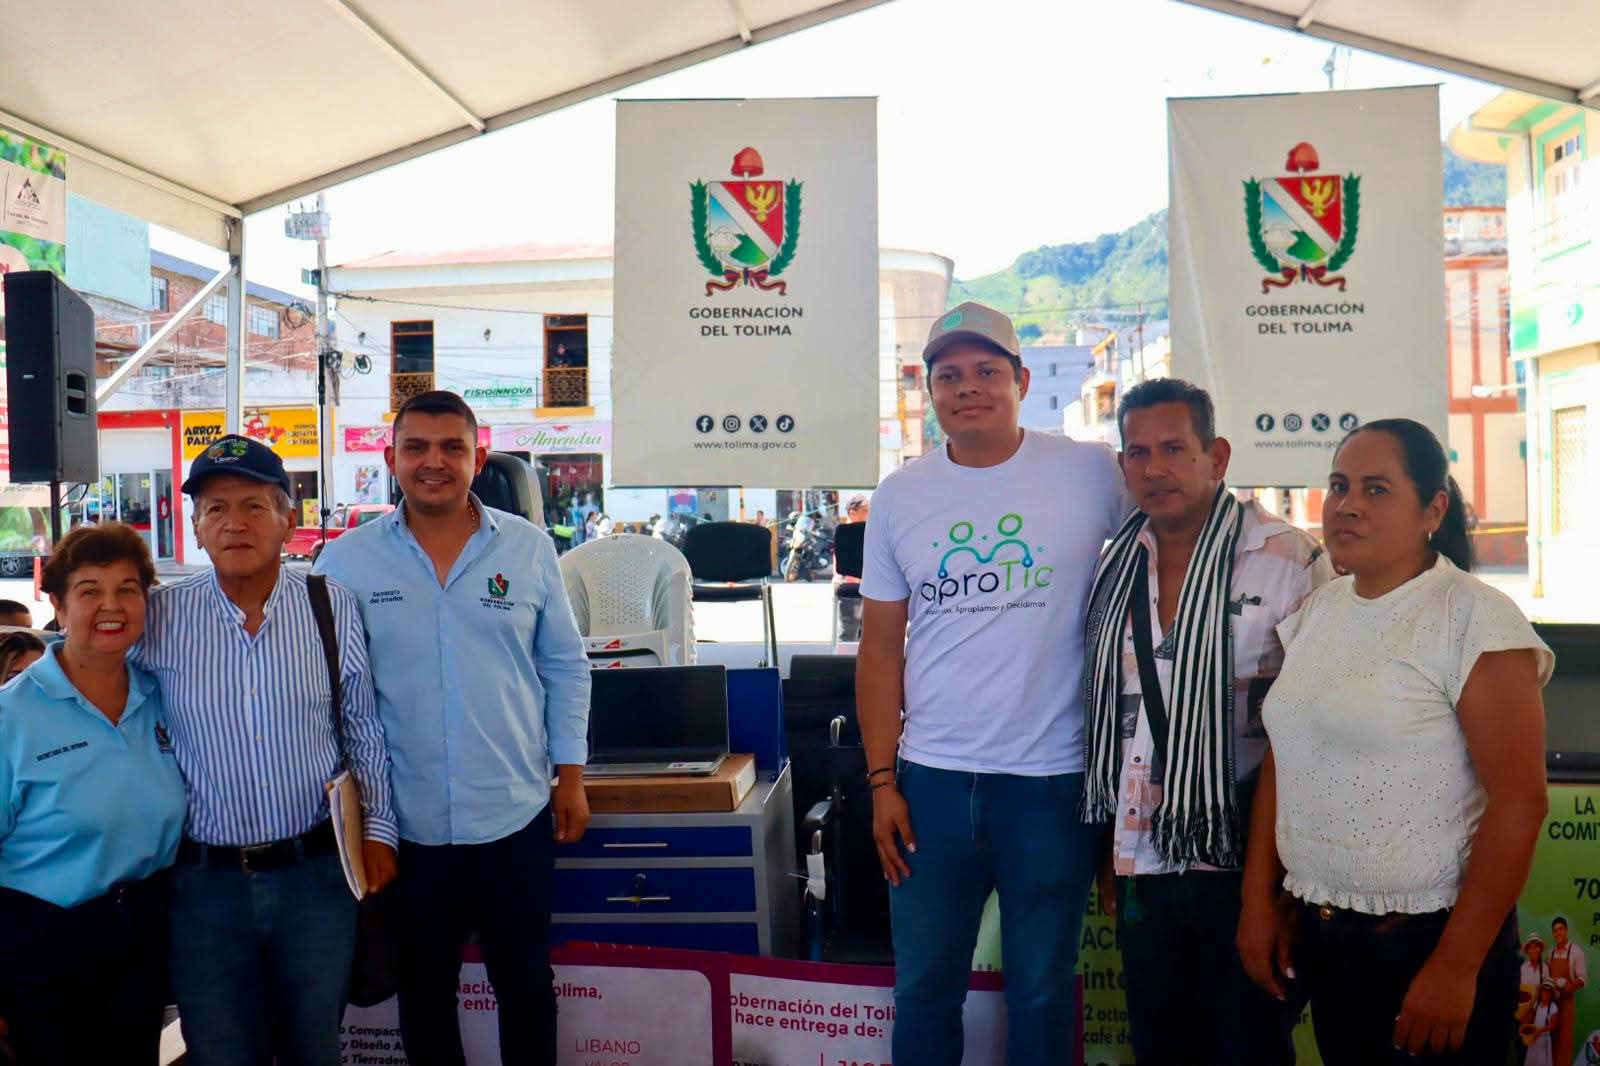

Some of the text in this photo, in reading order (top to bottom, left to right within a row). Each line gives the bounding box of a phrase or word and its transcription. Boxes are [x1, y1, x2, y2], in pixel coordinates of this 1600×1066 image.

[689, 304, 803, 319] GOBERNACIÓN
[1246, 301, 1364, 316] GOBERNACIÓN
[701, 325, 792, 336] DEL TOLIMA
[1258, 321, 1353, 334] DEL TOLIMA
[185, 425, 222, 436] ARROZ
[187, 436, 217, 446] PAIS
[694, 440, 797, 451] www.tolima.gov.co
[1575, 796, 1595, 816] LA
[830, 1003, 858, 1018] del
[735, 1009, 883, 1038] hace entrega de:
[575, 1039, 641, 1055] LIBANO
